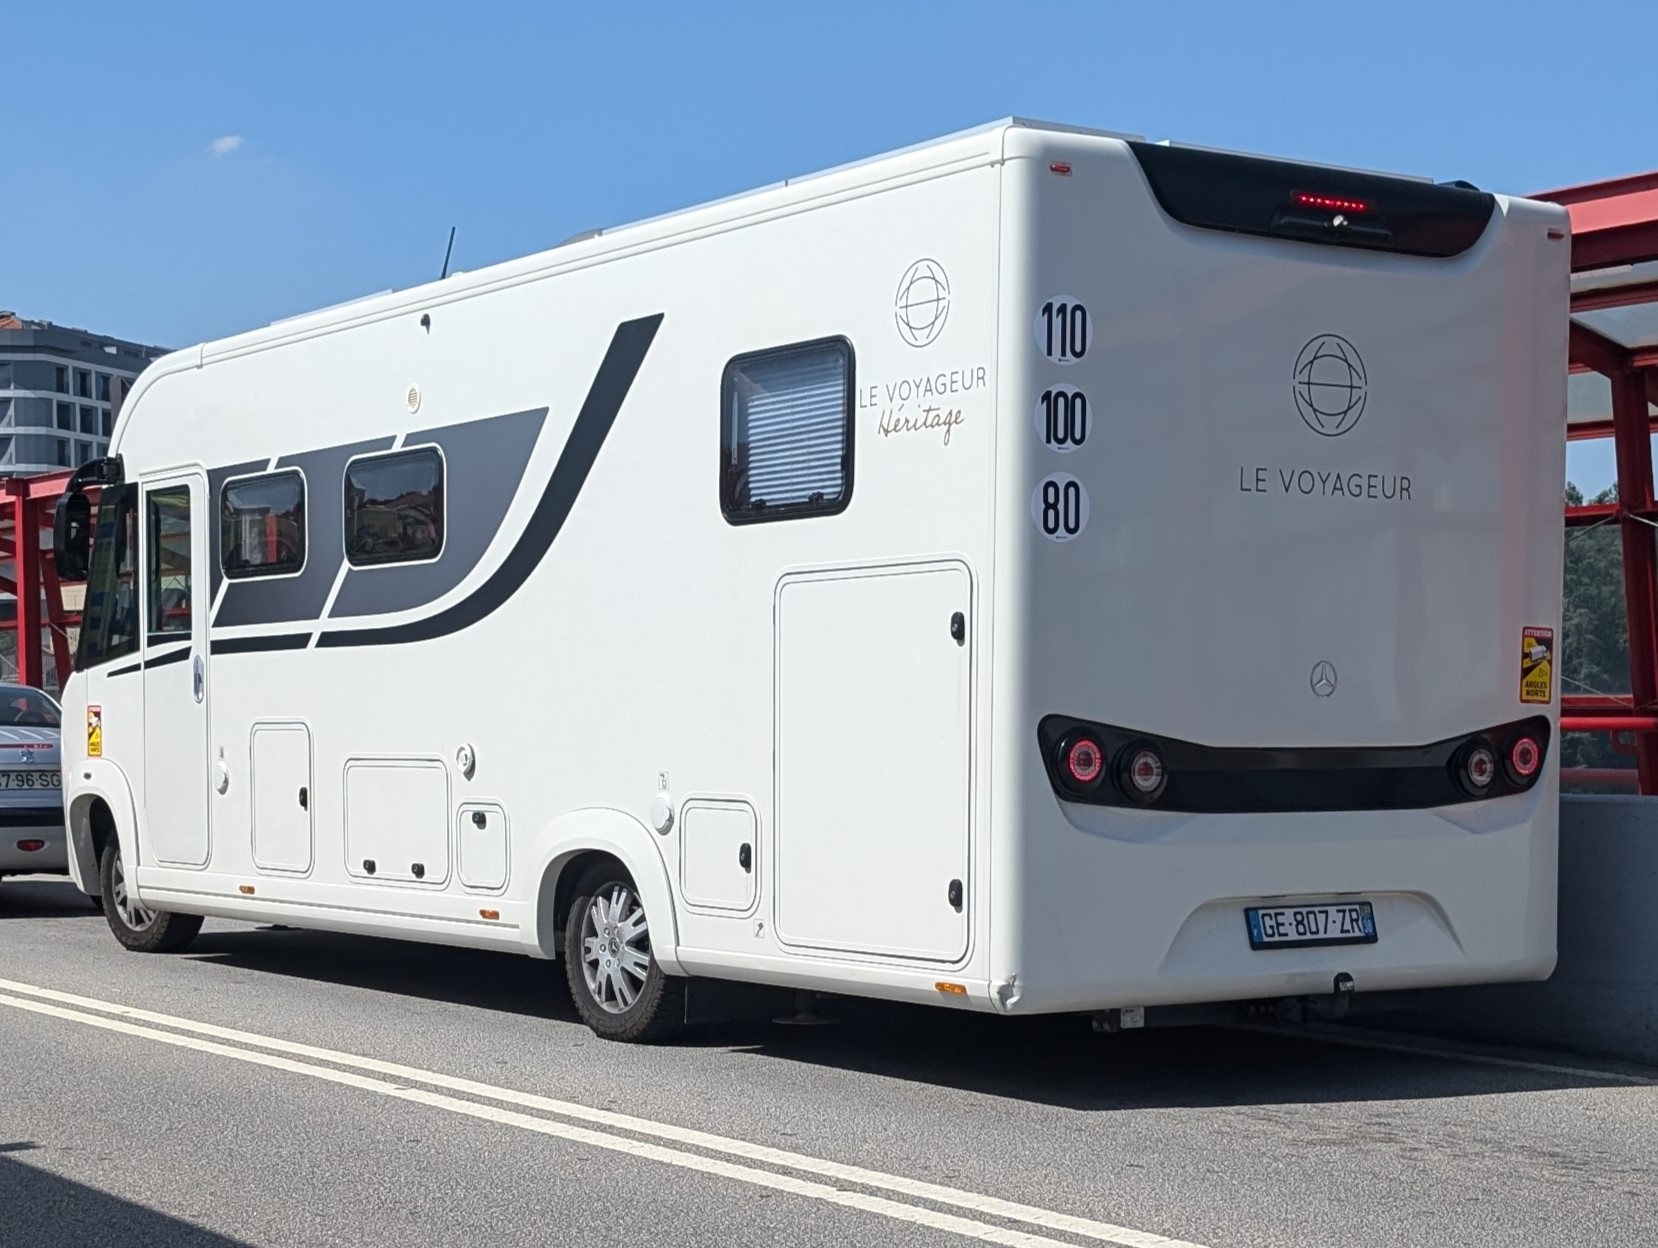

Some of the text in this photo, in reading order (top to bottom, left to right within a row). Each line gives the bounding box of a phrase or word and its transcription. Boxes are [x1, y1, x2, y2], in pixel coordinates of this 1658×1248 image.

[1041, 301, 1087, 359] 110
[859, 366, 986, 409] LE VOYAGEUR
[877, 403, 965, 446] Héritage
[1040, 389, 1087, 446] 100
[1240, 466, 1411, 500] LE VOYAGEUR
[1042, 480, 1081, 535] 80
[1524, 681, 1548, 690] ANGLES
[1525, 689, 1546, 698] MORTS
[0, 773, 61, 788] 7-96-SG
